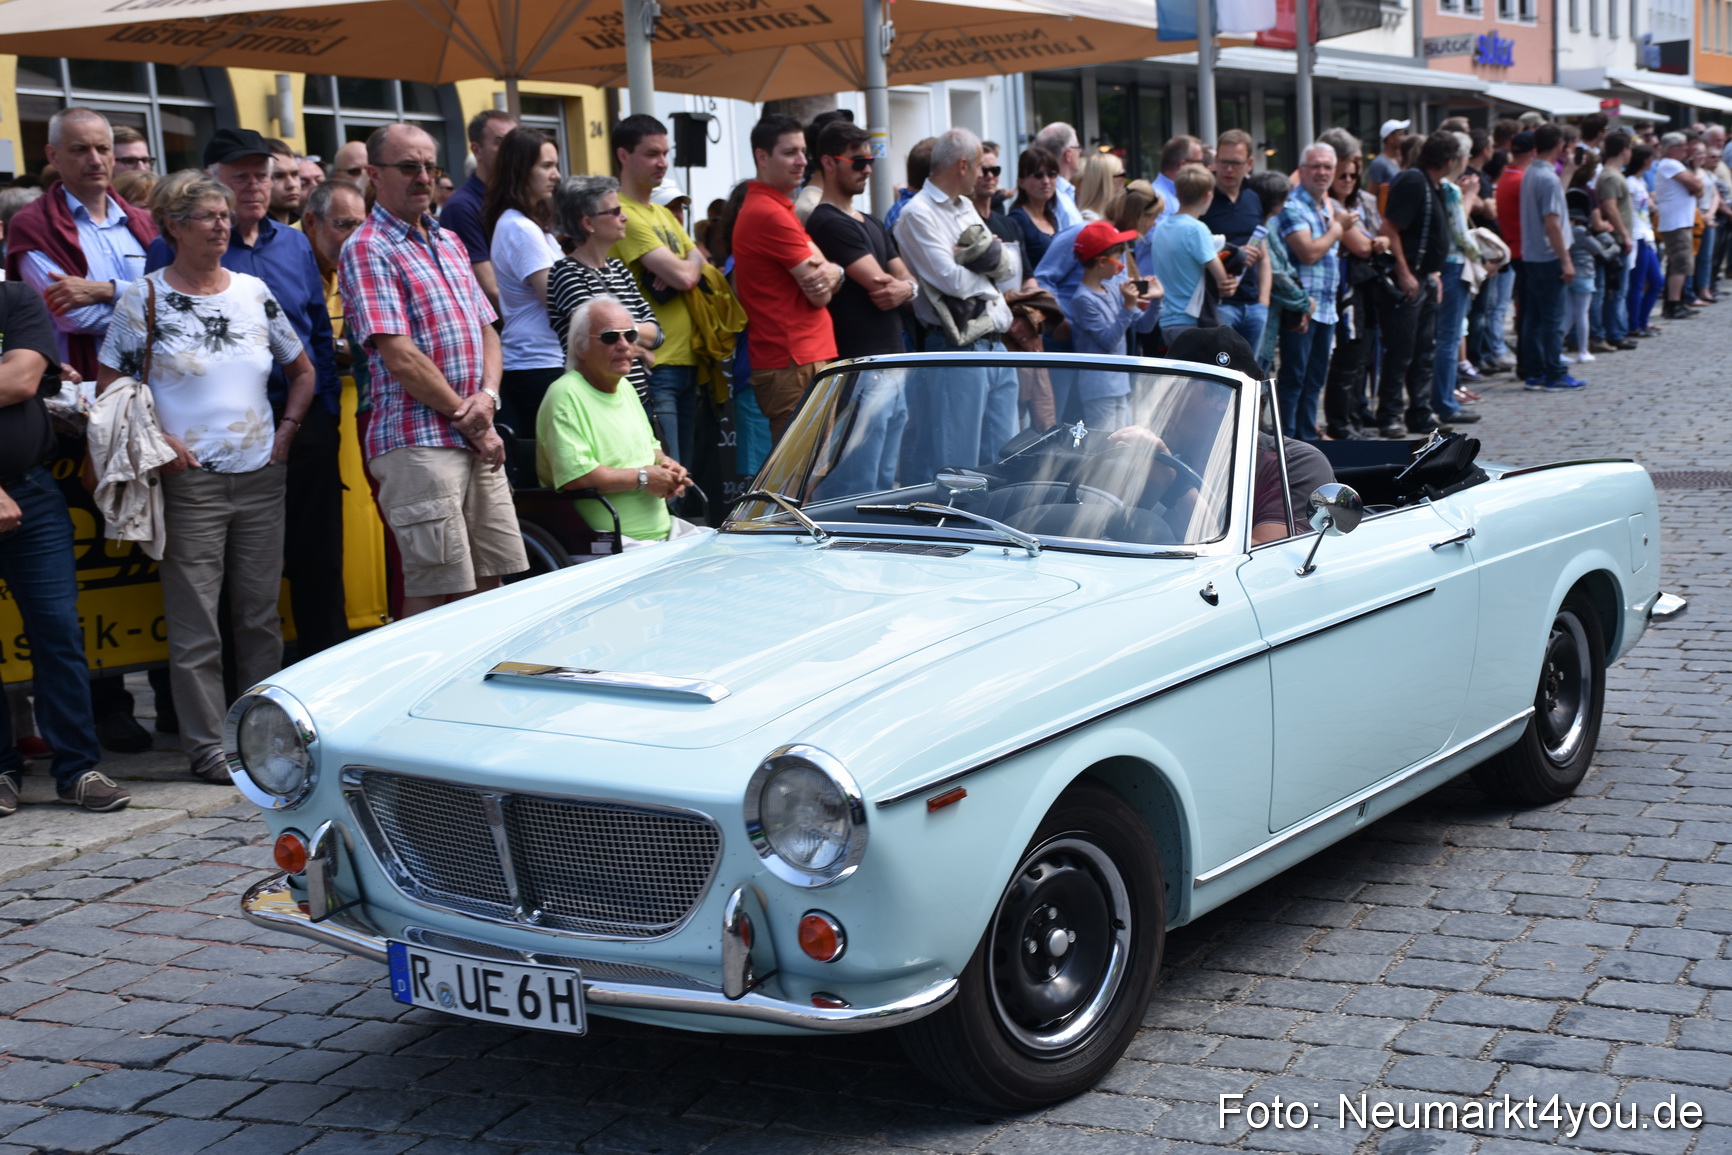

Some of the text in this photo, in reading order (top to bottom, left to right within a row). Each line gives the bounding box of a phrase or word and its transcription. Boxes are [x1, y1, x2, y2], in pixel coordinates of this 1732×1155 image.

[410, 953, 577, 1026] R UE 6H
